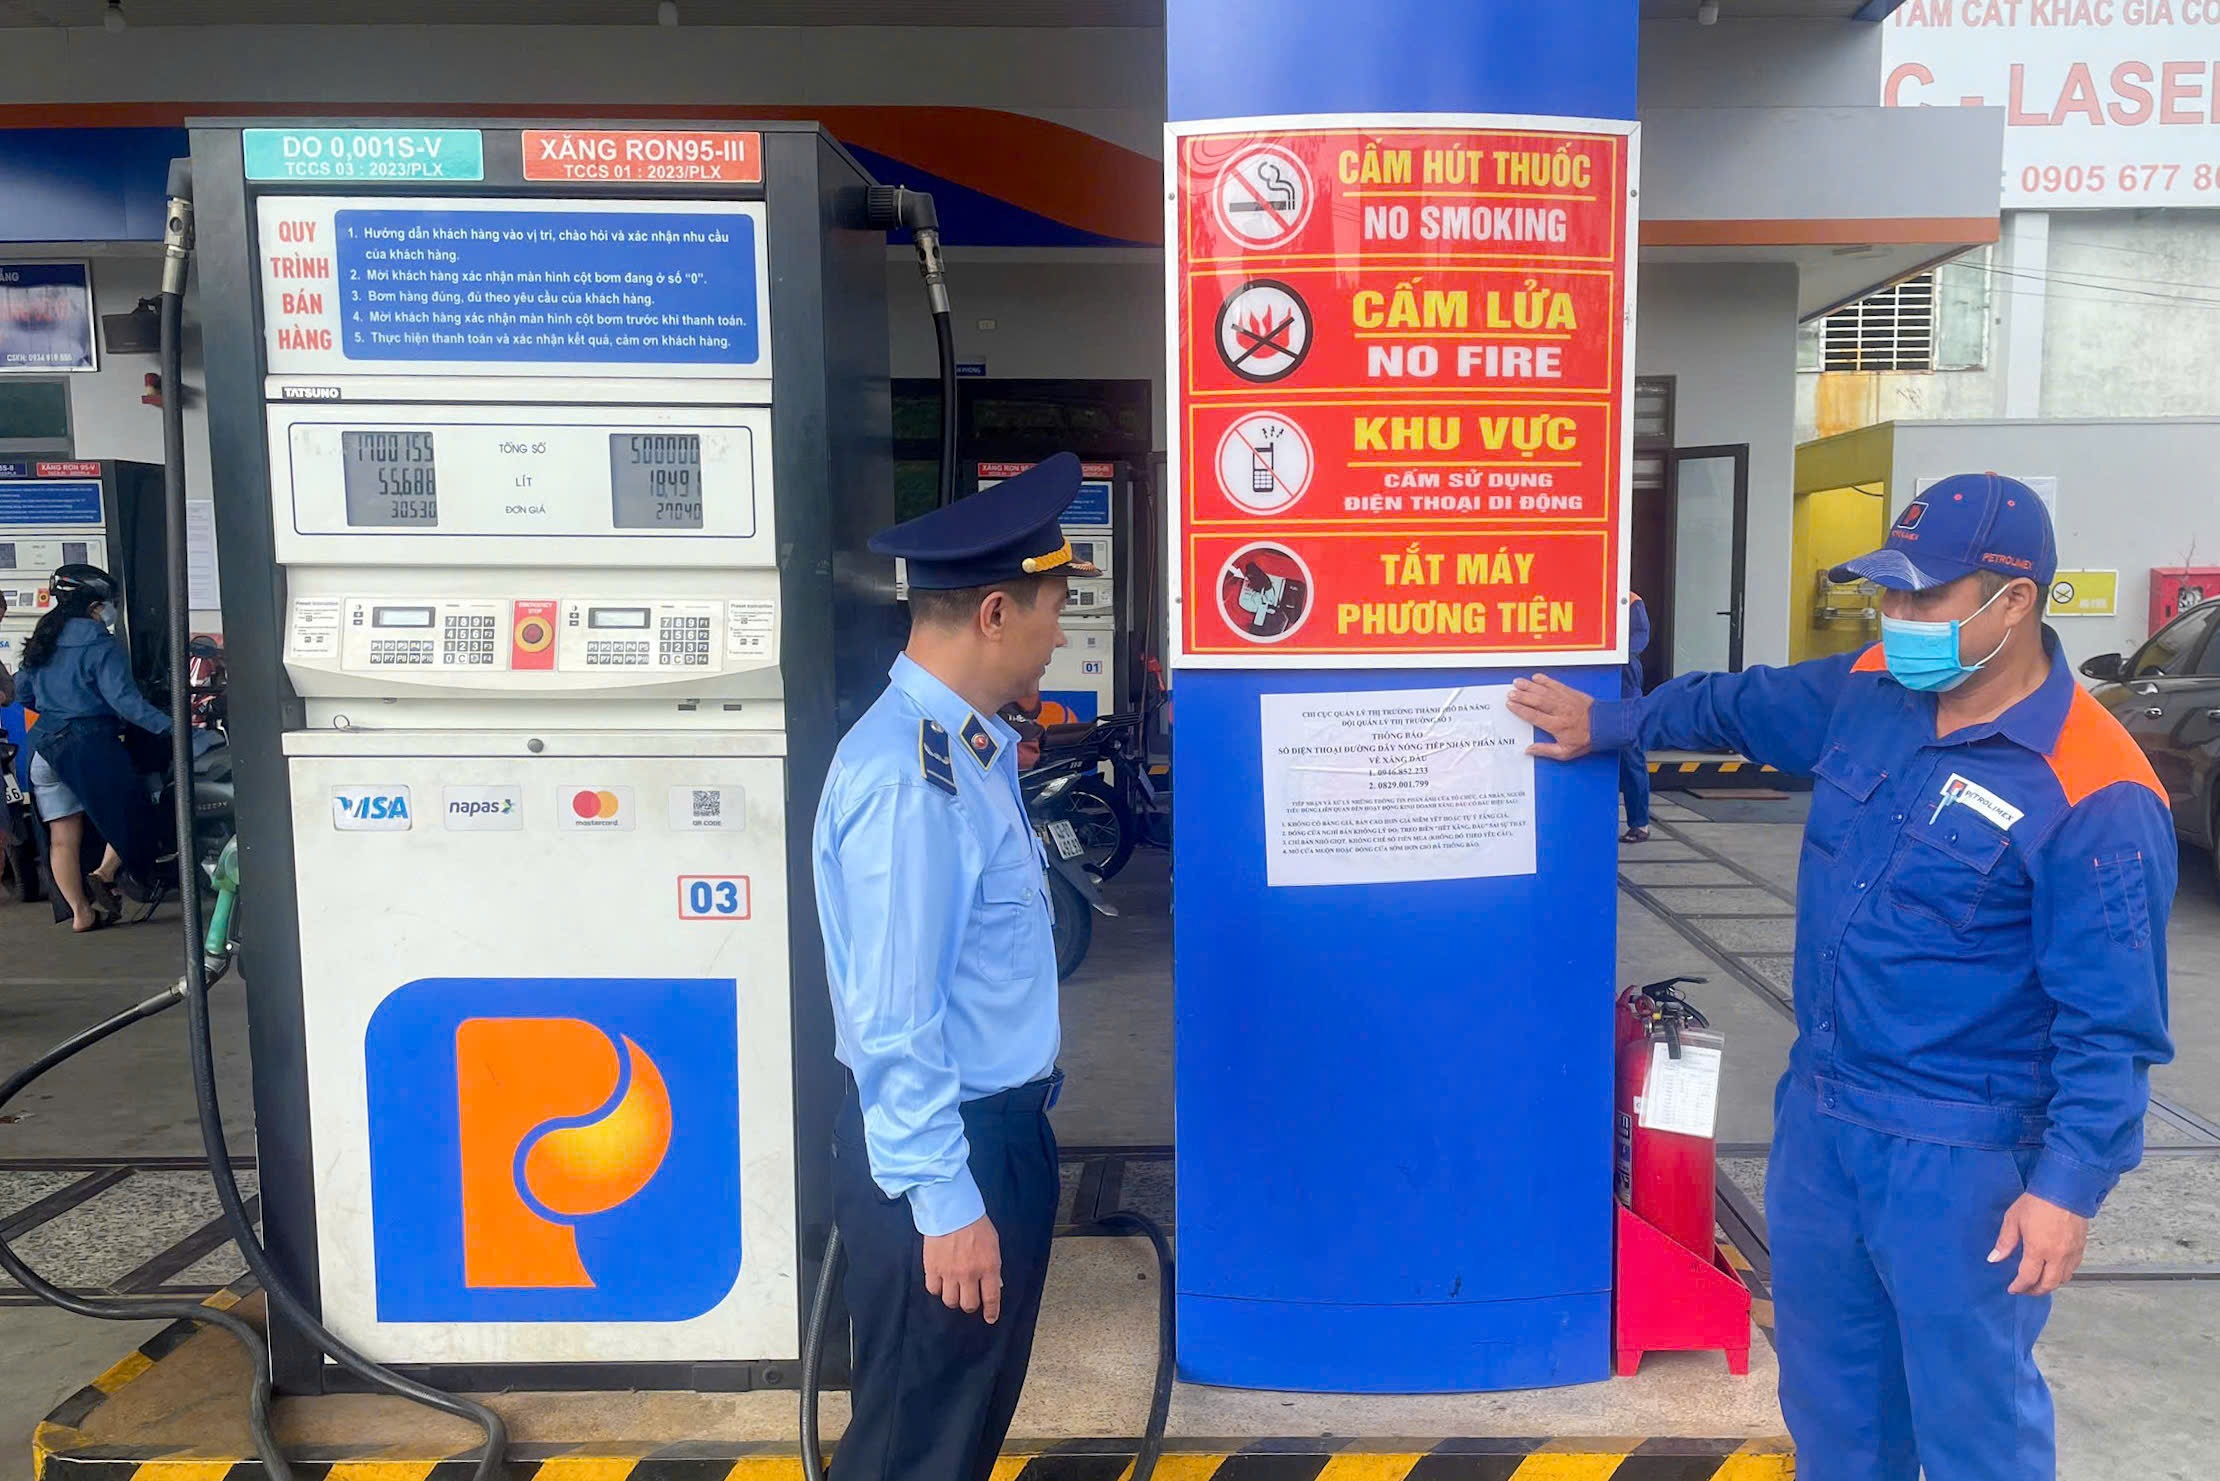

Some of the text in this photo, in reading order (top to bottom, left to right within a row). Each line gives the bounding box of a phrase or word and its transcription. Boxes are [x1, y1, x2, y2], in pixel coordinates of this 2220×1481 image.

[283, 136, 442, 161] DO 0,001S-V
[541, 135, 745, 162] XĂNG RON95-III
[286, 162, 443, 177] TCCS 03 2023/PLX
[564, 165, 721, 179] TCCS 01 2023/PLX
[1338, 138, 1591, 188] CẤM HÚT THUỐC
[2021, 165, 2106, 192] 0905
[2119, 164, 2181, 192] 677
[279, 221, 317, 244] QUY
[348, 225, 729, 244] 1. Hướng dẫn khách hàng vào vị trí, chào hỏi và xác nhận nhu cầu
[1365, 206, 1567, 243] NO SMOKING
[271, 251, 330, 279] TRÌNH
[366, 249, 460, 263] của khách hàng.
[350, 269, 360, 280] 2.
[367, 269, 389, 280] Mời
[392, 269, 426, 281] khách
[430, 270, 459, 284] hàng
[462, 271, 482, 281] xác
[486, 271, 514, 284] nhận
[517, 271, 541, 282] màn
[546, 271, 570, 283] hình
[574, 271, 592, 284] cột
[595, 272, 621, 283] bơm
[624, 272, 653, 286] đang
[656, 272, 665, 283] ở
[668, 270, 682, 284] số
[282, 287, 323, 315] BÁN
[351, 289, 655, 307] 3. Bơm hàng đúng, đủ theo yêu cầu của khách hàng.
[1352, 276, 1577, 331] CẤM LỬA
[352, 310, 747, 327] 4. Mời khách hàng xác nhận màn hình cột bơm trước khi thanh toán.
[278, 322, 333, 351] HÀNG
[354, 331, 731, 350] 5. Thực hiện thanh toán và xác nhận kết quả, cảm ơn khách hàng.
[1367, 346, 1562, 379] NO FIRE
[284, 387, 339, 399] TATSUNO
[1354, 413, 1578, 458] KHU VỰC
[531, 440, 547, 454] SỐ
[631, 436, 701, 464] 500000
[515, 475, 533, 488] LÍT
[1384, 469, 1552, 491] CẤM SỬ DỤNG
[391, 500, 438, 519] 30530
[505, 503, 546, 515] ĐƠN GIÁ
[1344, 493, 1583, 514] ĐIỆN THOẠI DI ĐỘNG
[1381, 540, 1535, 586] TẮT MÁY
[1982, 552, 2034, 571] PETROLIMEX
[1337, 596, 1573, 639] PHƯƠNG TIỆN
[1085, 663, 1100, 673] 01
[1377, 779, 1429, 790] 0829.001.799
[337, 796, 409, 820] VISA
[449, 800, 500, 817] napas
[575, 819, 619, 827] mastercard
[690, 881, 738, 915] 03
